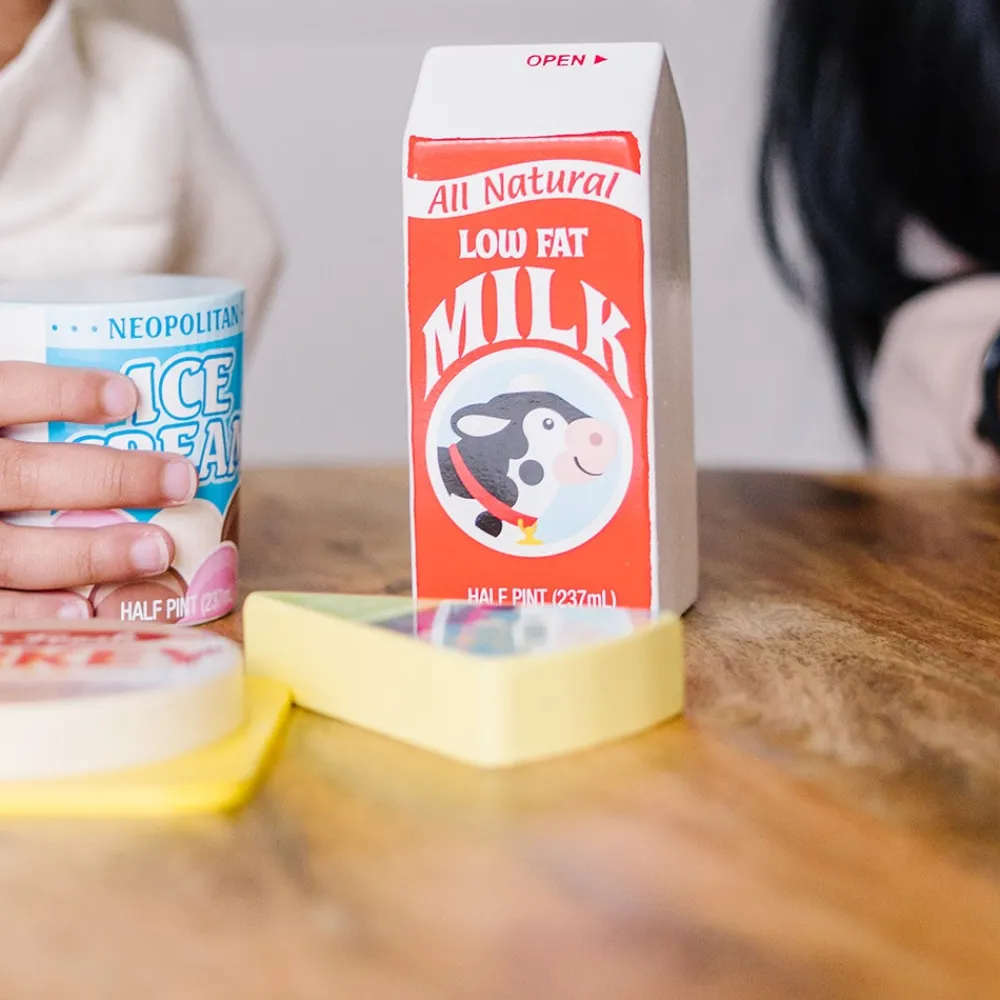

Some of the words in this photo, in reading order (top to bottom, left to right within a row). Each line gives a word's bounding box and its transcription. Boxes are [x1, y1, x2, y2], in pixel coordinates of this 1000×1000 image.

[526, 54, 586, 67] OPEN
[427, 182, 468, 214] All
[484, 166, 620, 205] Natural
[458, 228, 527, 259] LOW
[536, 227, 589, 258] FAT
[108, 304, 239, 339] NEOPOLITAN
[421, 266, 633, 402] MILK
[124, 351, 235, 427] ICE
[120, 599, 162, 621] HALF
[166, 595, 198, 619] PINT
[467, 587, 508, 605] HALF
[512, 587, 548, 607] PINT
[552, 588, 617, 608] (237mL)
